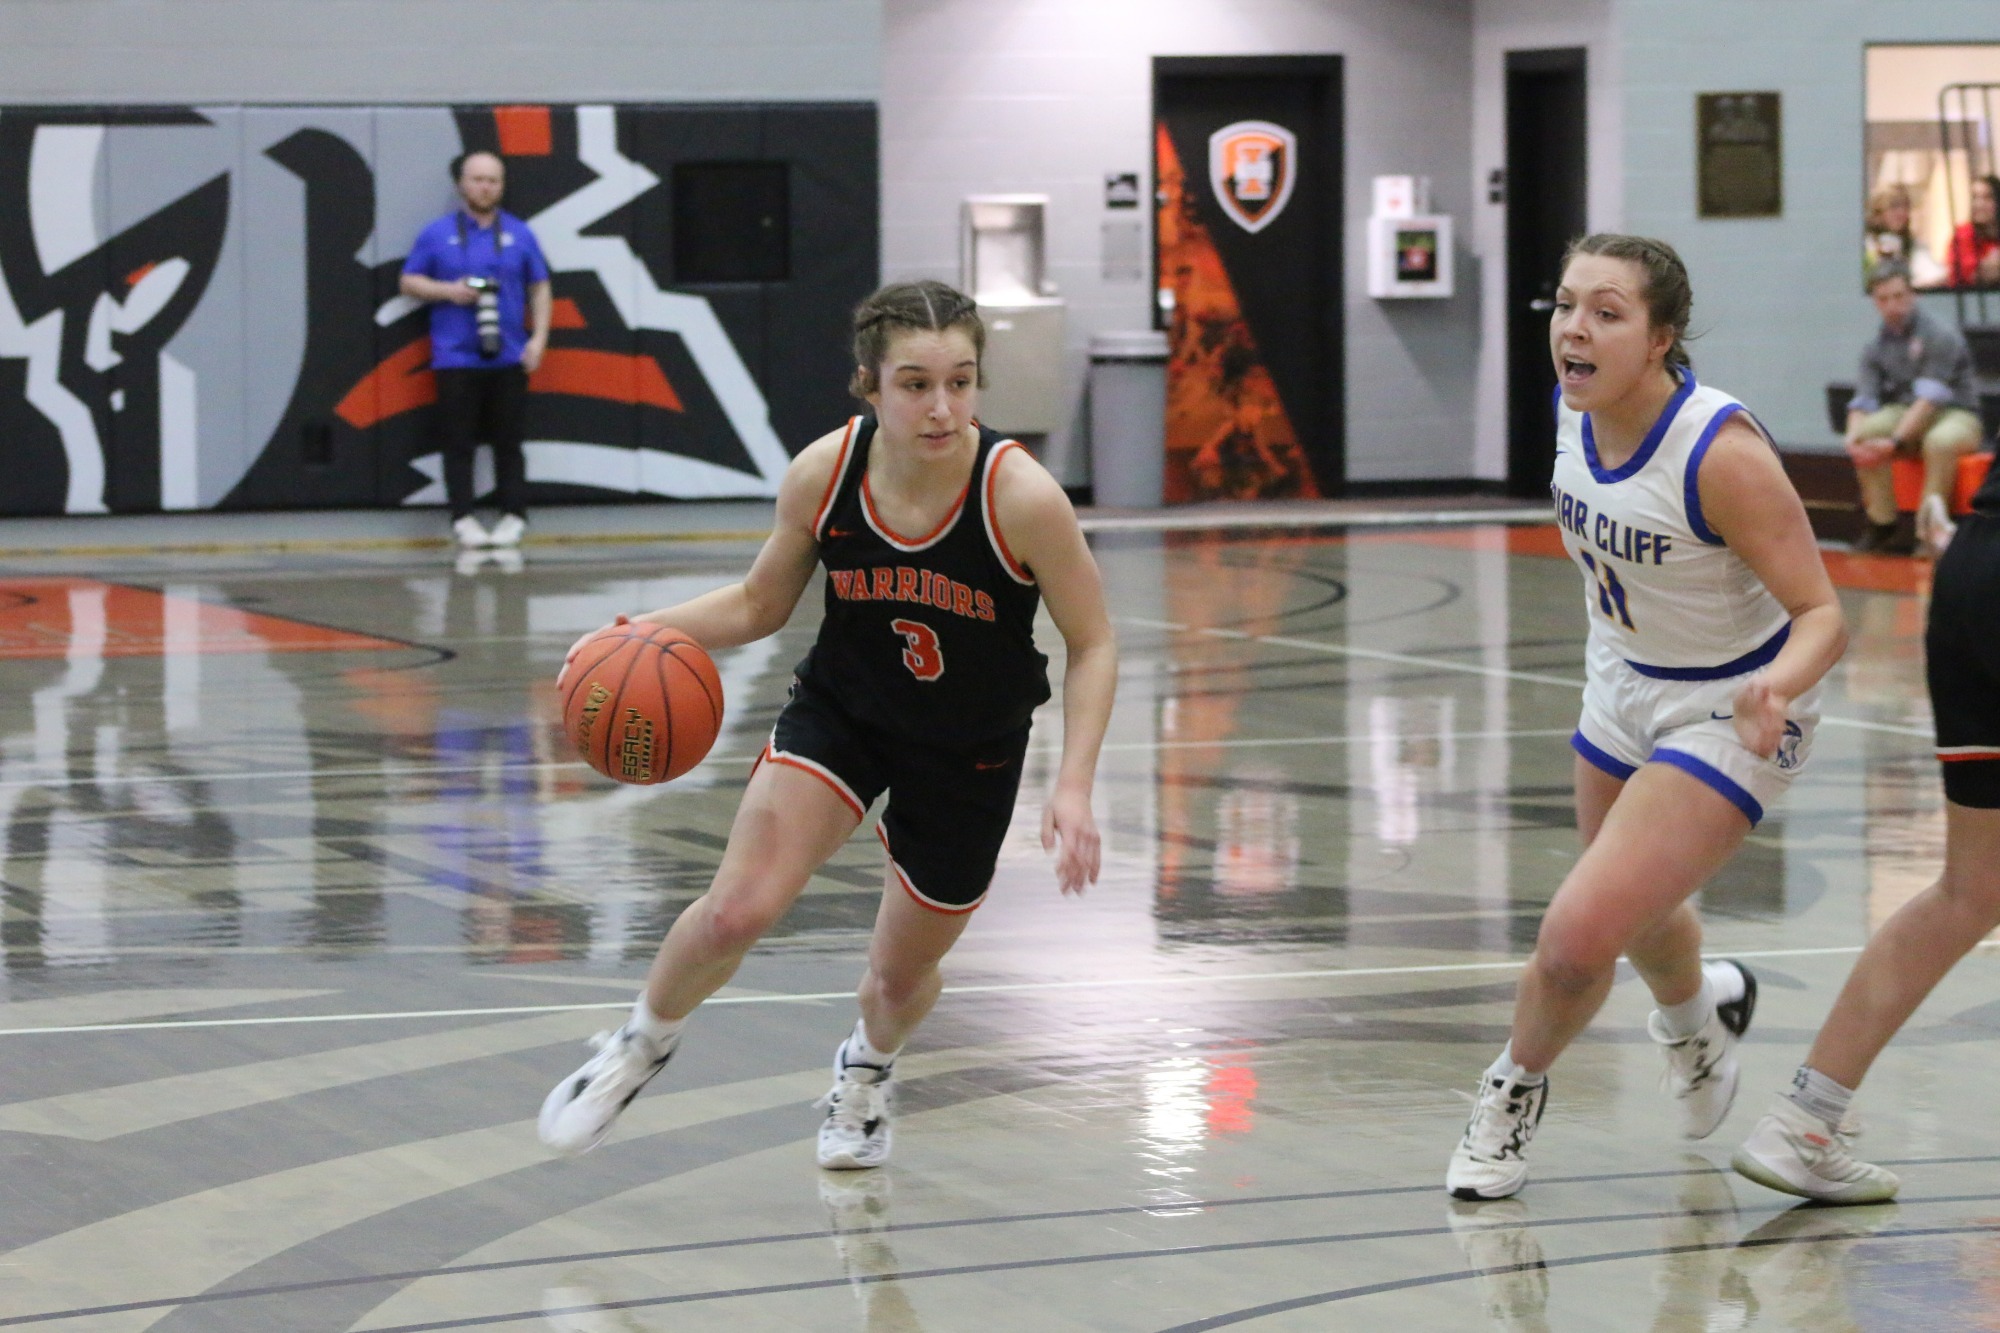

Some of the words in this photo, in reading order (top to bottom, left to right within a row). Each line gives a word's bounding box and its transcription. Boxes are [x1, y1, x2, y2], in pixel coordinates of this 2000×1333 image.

[1595, 512, 1672, 565] CLIFF
[829, 567, 995, 621] WARRIORS
[1579, 547, 1637, 633] 11
[891, 618, 945, 681] 3
